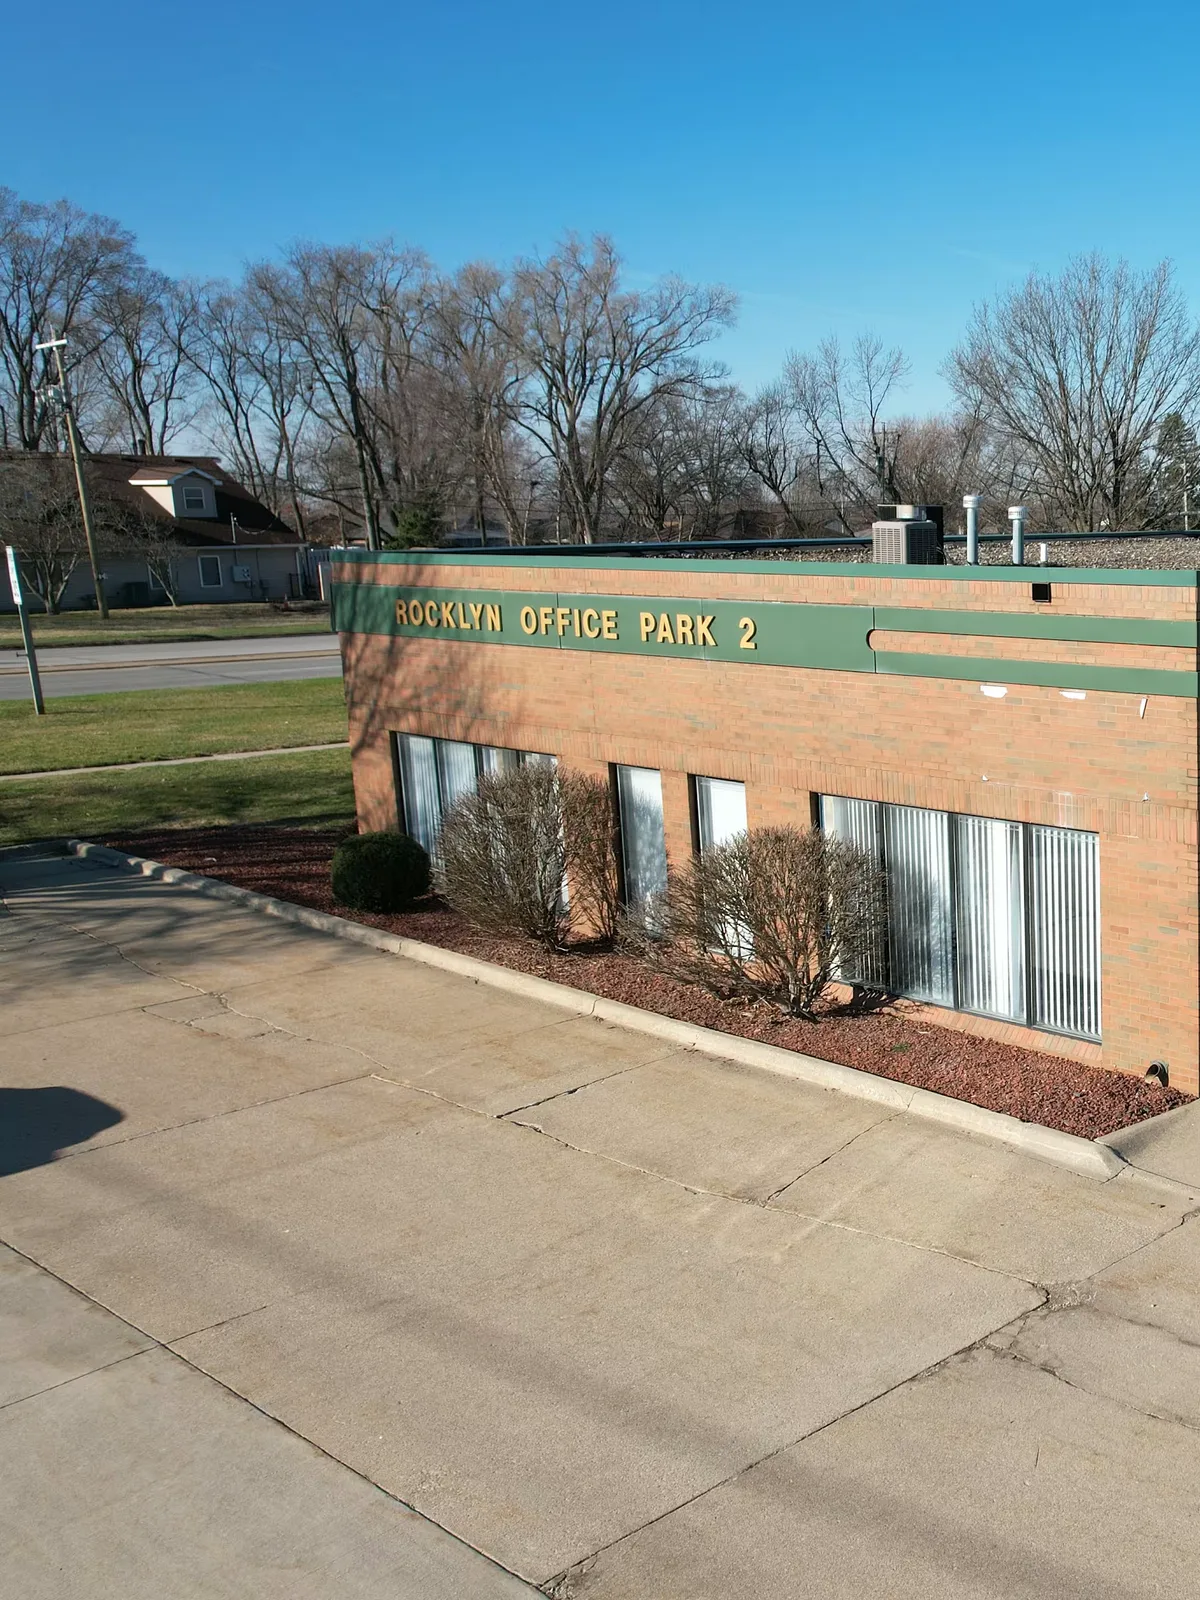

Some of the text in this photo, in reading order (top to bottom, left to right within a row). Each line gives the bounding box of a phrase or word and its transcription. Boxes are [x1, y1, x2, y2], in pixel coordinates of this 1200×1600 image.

[395, 599, 757, 649] ROCKLYN OFFICE PARK 2
